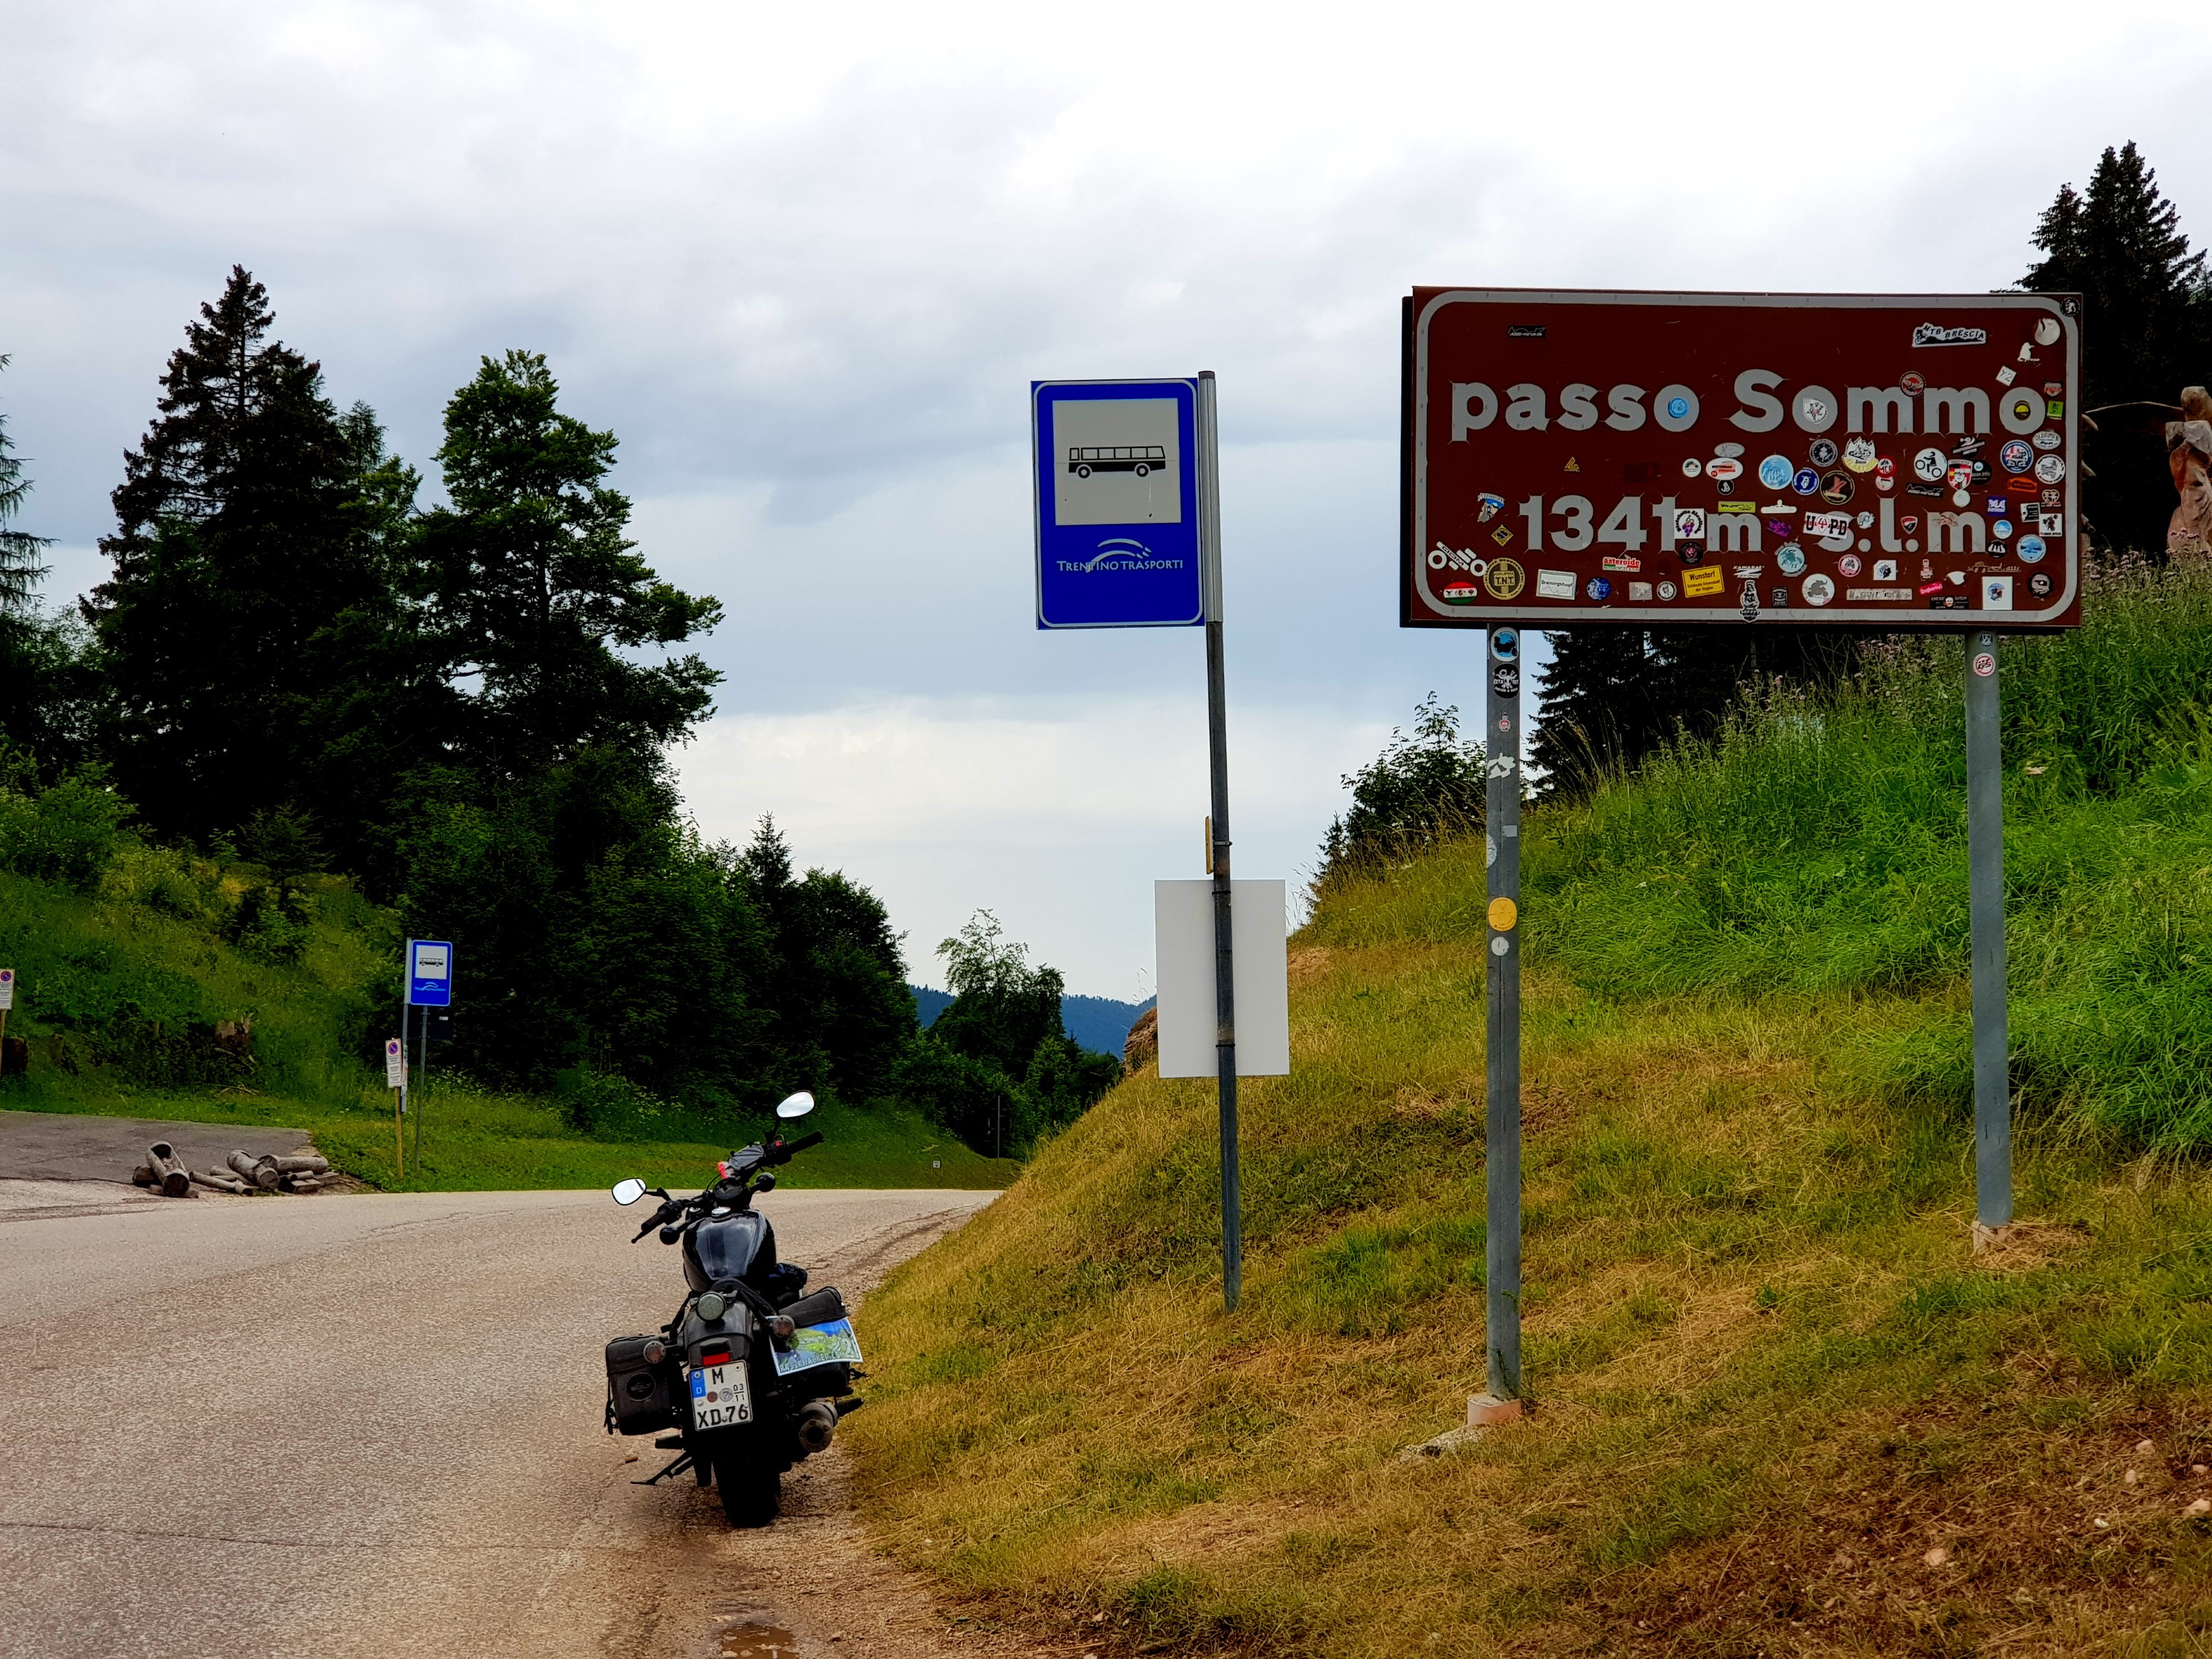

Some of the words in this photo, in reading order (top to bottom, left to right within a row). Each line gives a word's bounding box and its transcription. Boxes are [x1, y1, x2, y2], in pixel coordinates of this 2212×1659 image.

[1923, 325, 1942, 335] MTB
[1945, 329, 1984, 339] BRESCIA
[1451, 382, 1700, 442] passo
[1732, 369, 2046, 434] Sommo
[1519, 494, 1675, 552] 1341
[1706, 513, 1762, 552] m
[1057, 560, 1119, 572] TRENTINO
[1120, 559, 1183, 570] TRASPORTI
[1689, 570, 1715, 581] Wunstorf
[712, 1367, 724, 1385] M
[733, 1383, 744, 1392] 03
[697, 1408, 722, 1428] XD
[725, 1404, 748, 1423] 76
